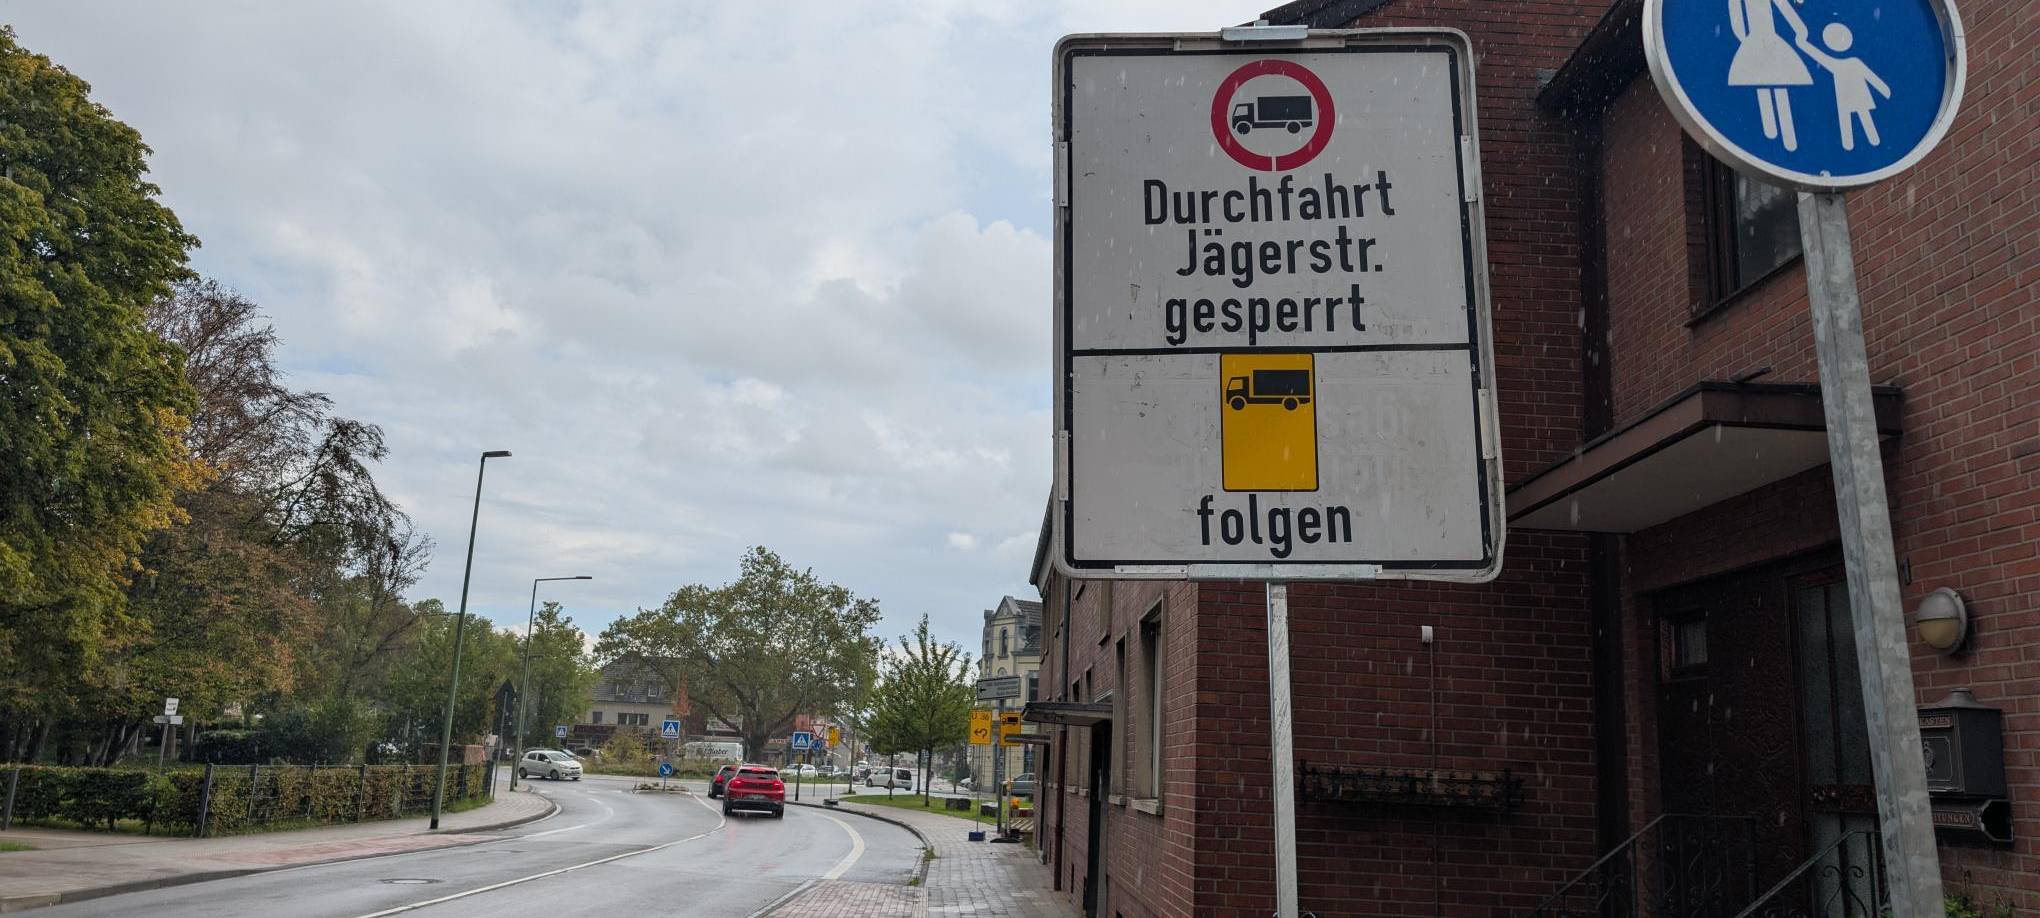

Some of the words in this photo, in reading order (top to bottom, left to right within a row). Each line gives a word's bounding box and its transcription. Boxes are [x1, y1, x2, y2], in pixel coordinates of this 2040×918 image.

[1143, 171, 1396, 226] Durchfahrt
[1176, 226, 1383, 289] Jägerstr.
[1166, 284, 1366, 347] gesperrt
[1197, 493, 1353, 559] folgen
